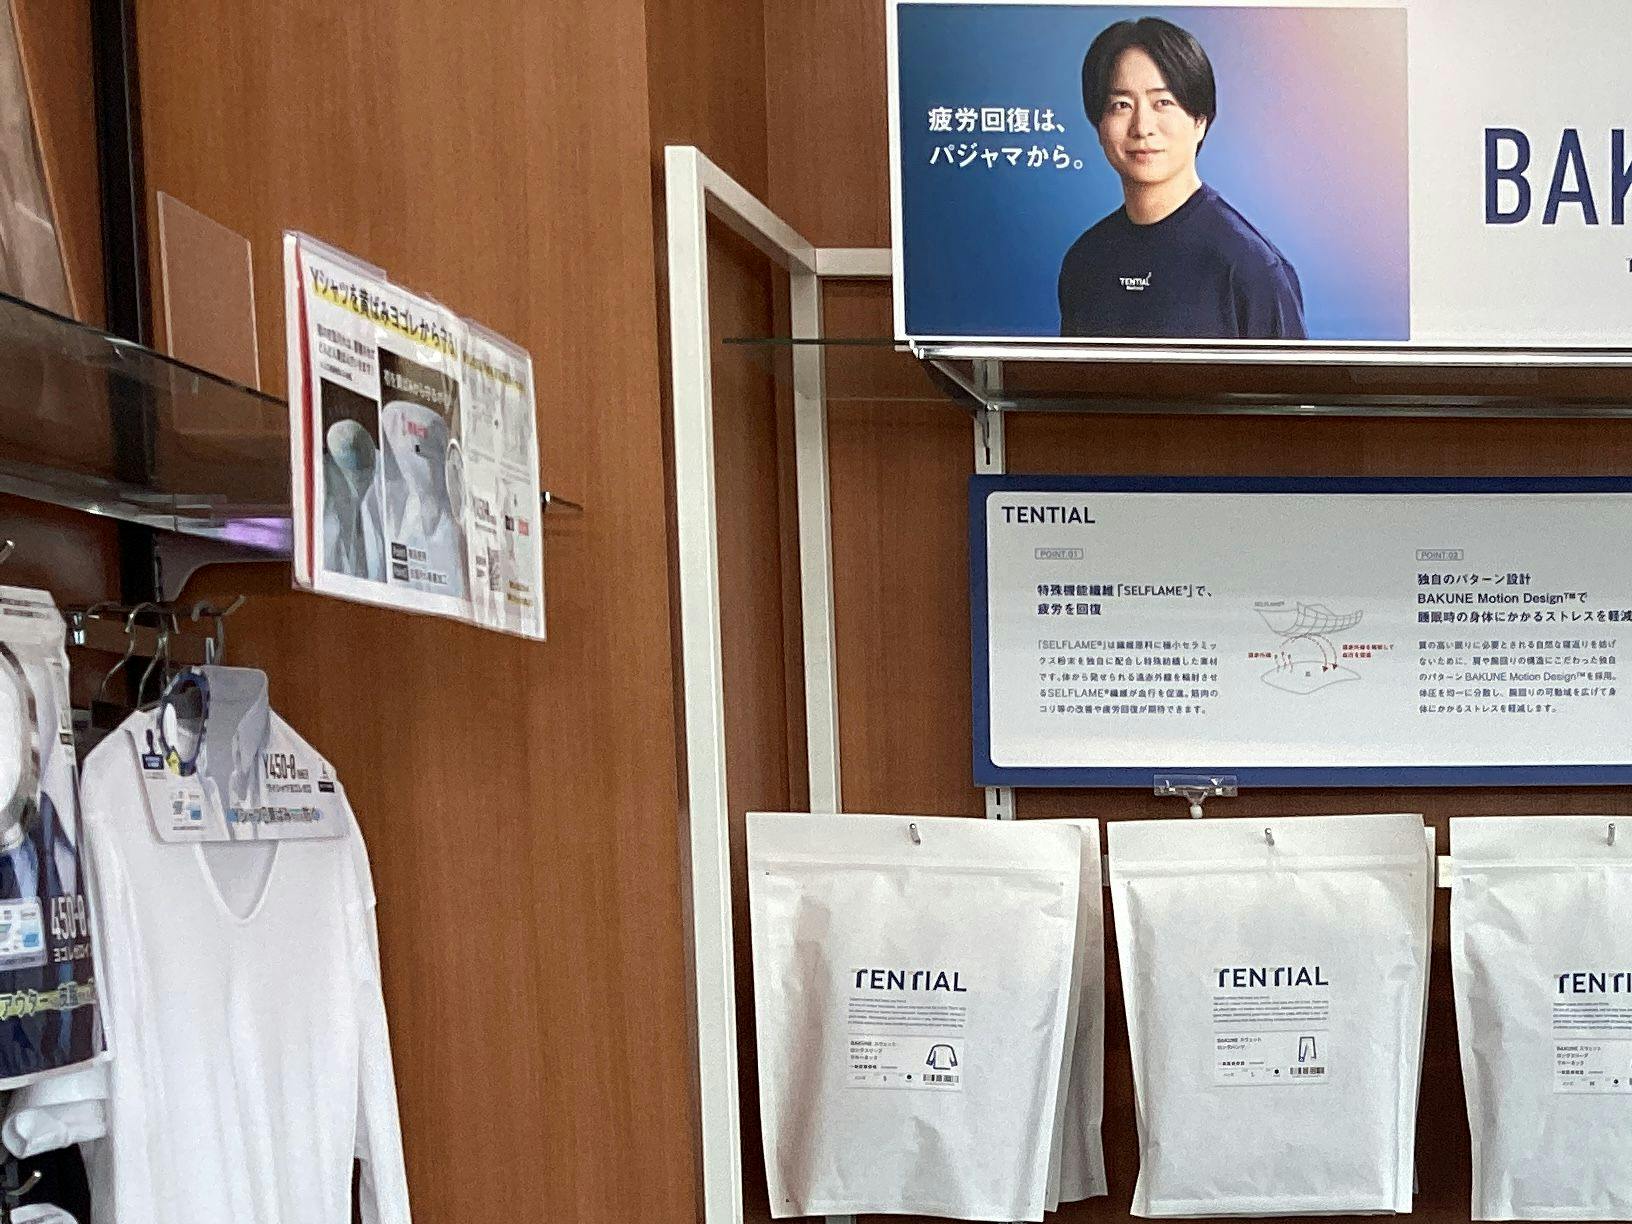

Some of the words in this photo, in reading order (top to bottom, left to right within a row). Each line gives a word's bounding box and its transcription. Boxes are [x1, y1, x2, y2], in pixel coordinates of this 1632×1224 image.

[928, 106, 1066, 135] 疲労回復は、
[928, 142, 1085, 171] パジャマから。
[1001, 505, 1096, 525] TENTIAL
[1417, 573, 1531, 586] 独自のパターン設計
[1418, 592, 1473, 604] BAKUNE
[1477, 592, 1519, 604] Motion
[1037, 603, 1102, 616] 疲労を回復
[852, 968, 968, 992] TENTIAL
[1214, 965, 1329, 988] TENTIAL
